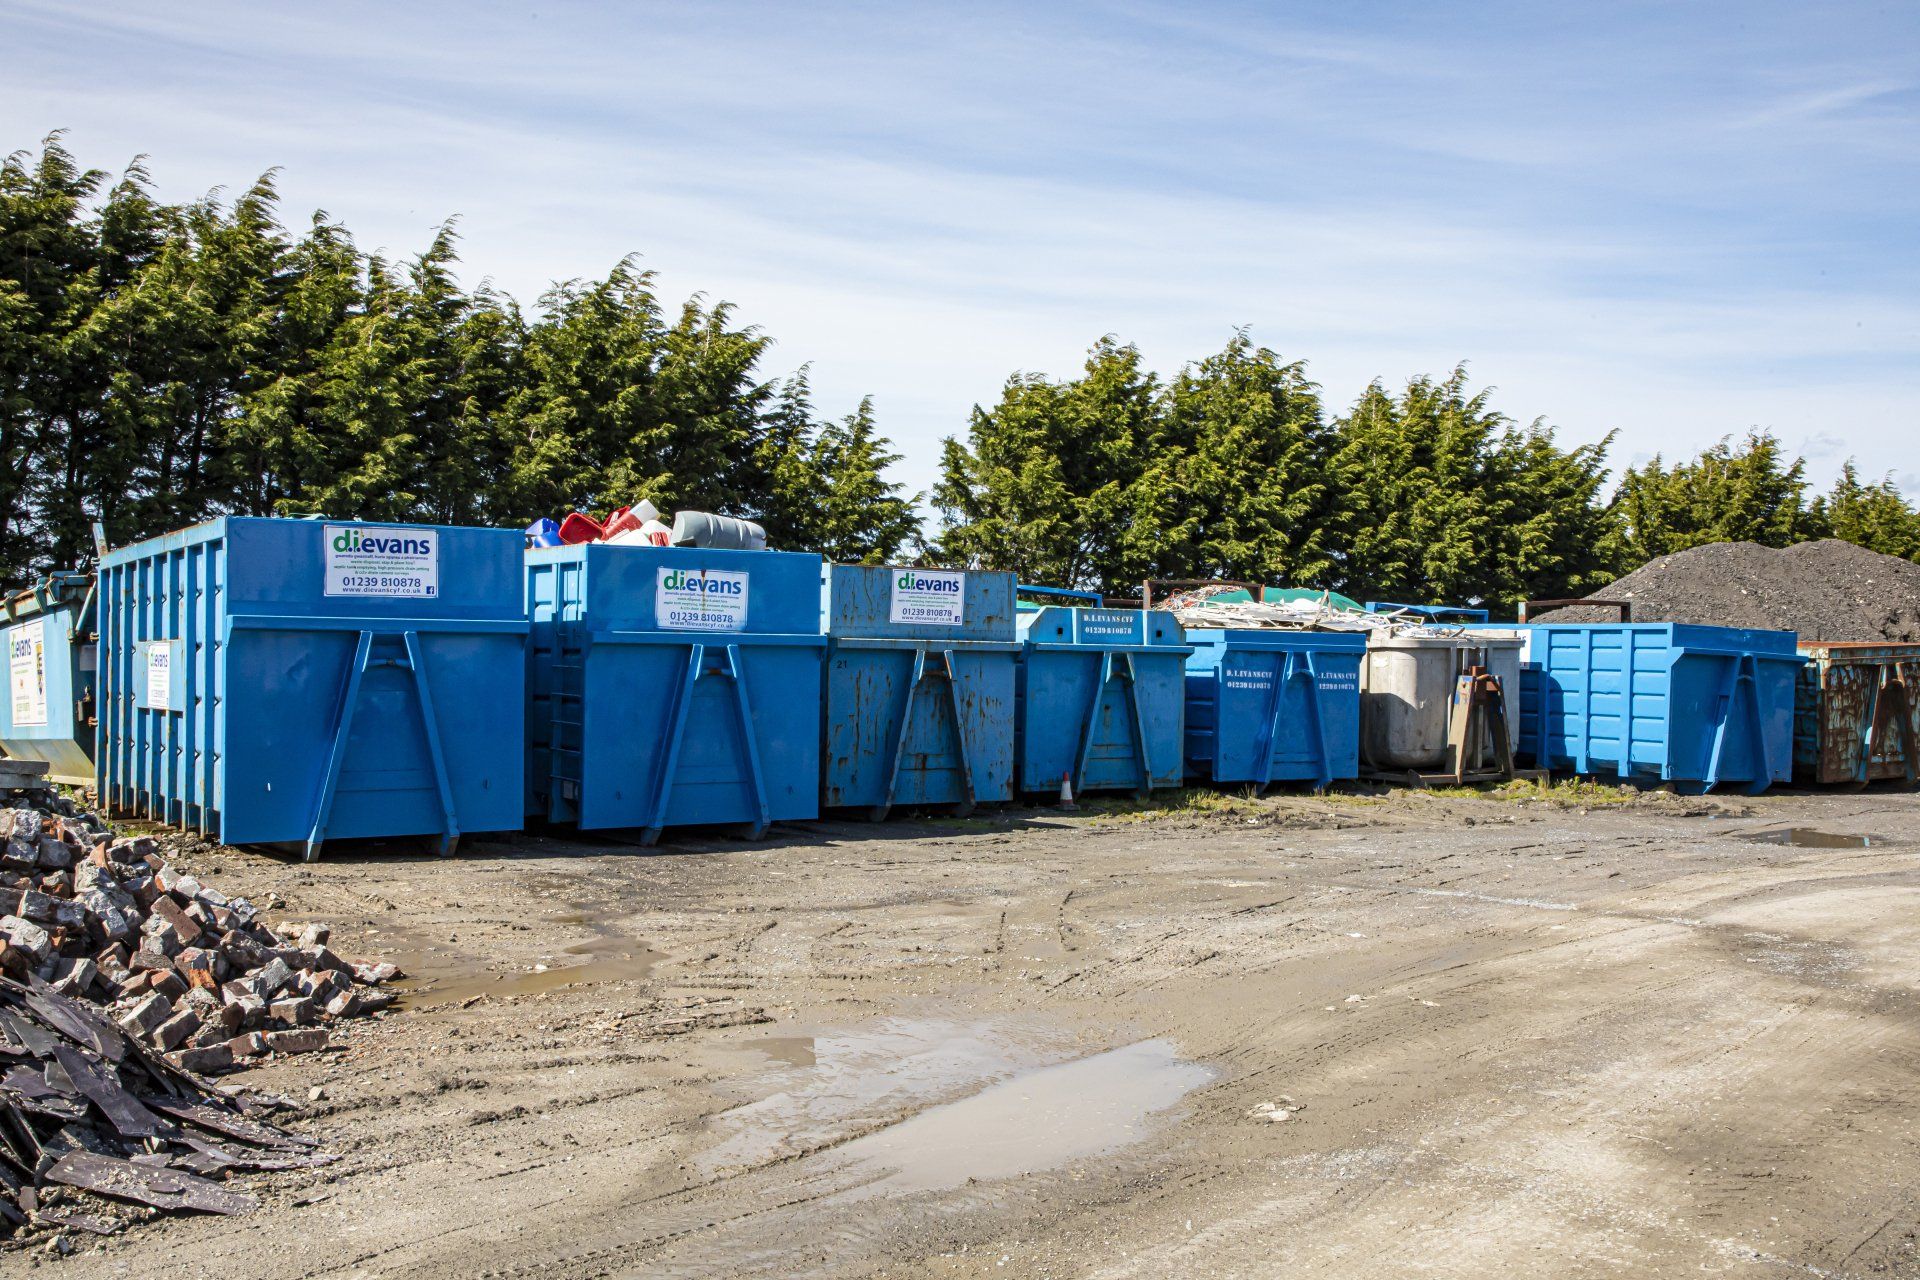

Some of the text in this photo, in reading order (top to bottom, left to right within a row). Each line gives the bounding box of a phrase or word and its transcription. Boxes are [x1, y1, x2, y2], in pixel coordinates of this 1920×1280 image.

[342, 577, 421, 588] 01239 810878
[670, 612, 733, 623] 01239 810878
[926, 608, 952, 617] 810878
[837, 660, 846, 668] 21
